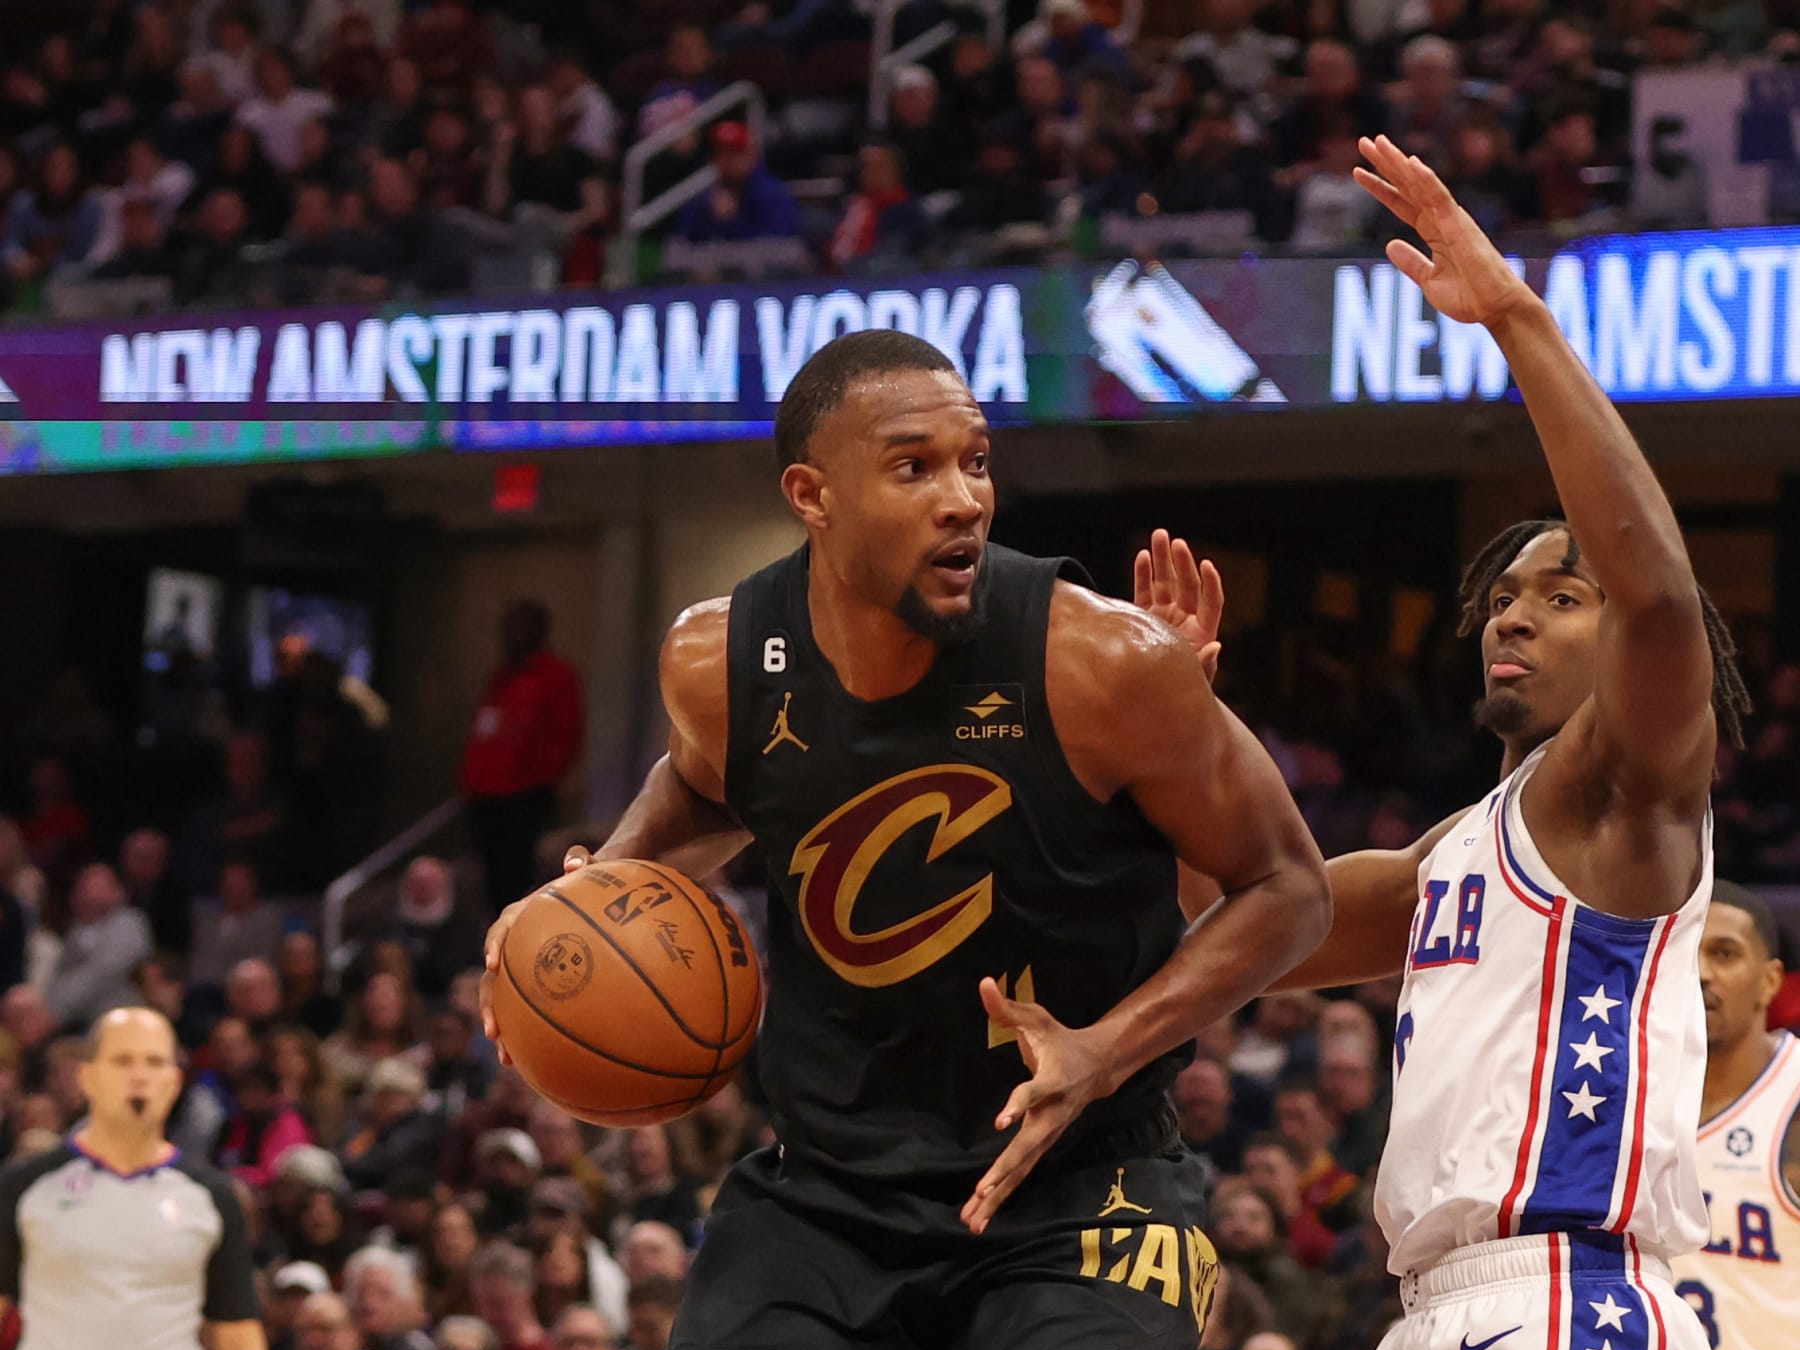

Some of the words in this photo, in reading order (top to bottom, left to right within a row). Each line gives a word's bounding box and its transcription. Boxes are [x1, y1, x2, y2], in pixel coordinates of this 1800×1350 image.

[99, 325, 261, 402] NEW
[267, 298, 740, 403] AMSTERDAM
[763, 636, 786, 673] 6
[955, 724, 1024, 740] CLIFFS
[788, 763, 1012, 988] C
[1407, 873, 1486, 976] LA
